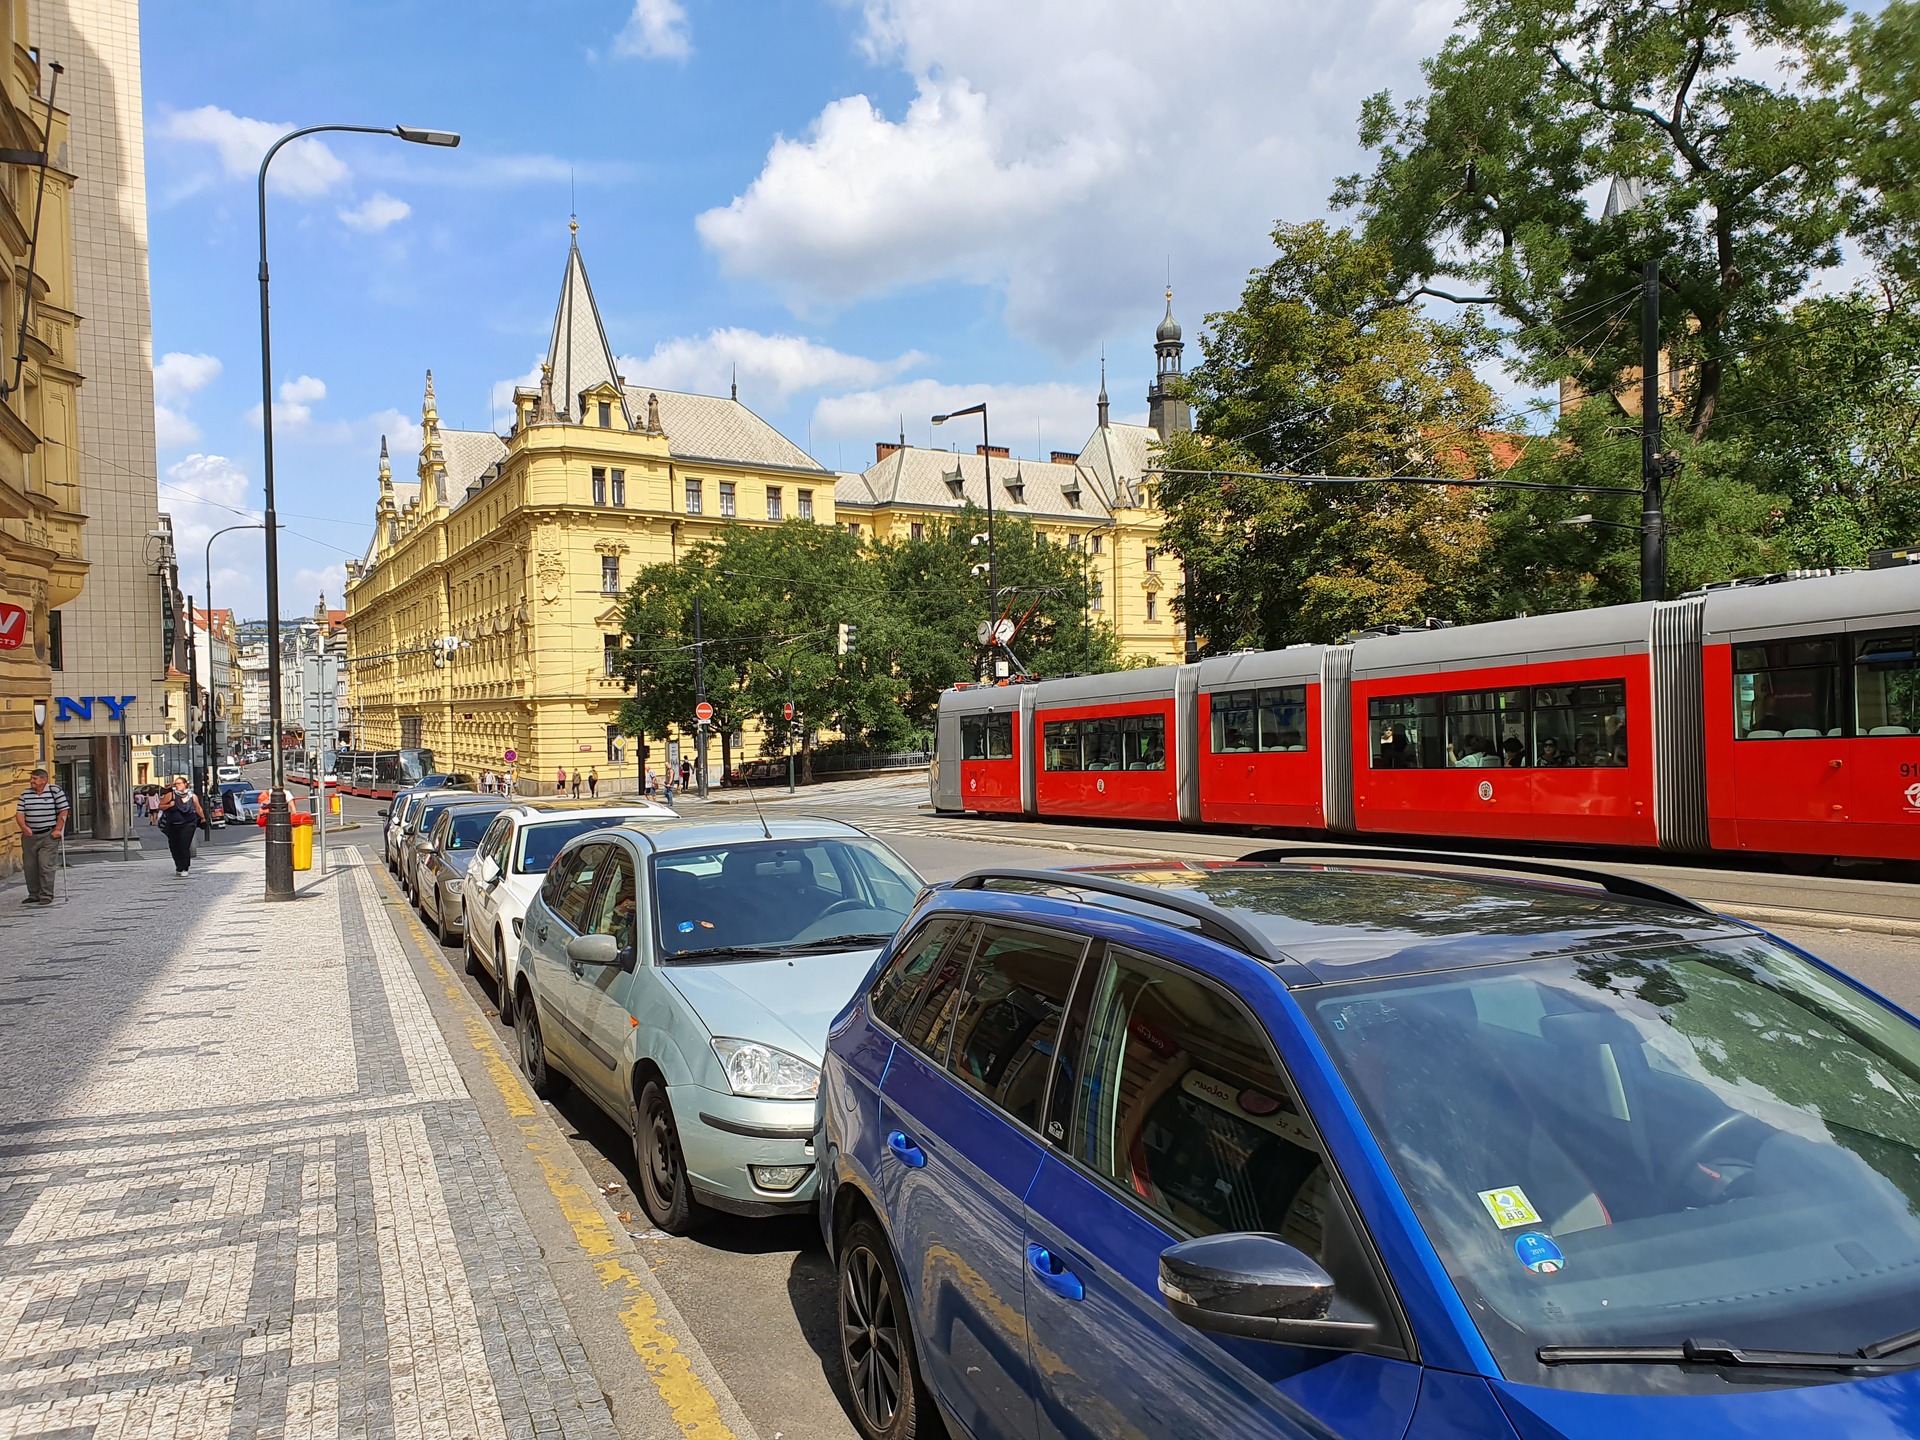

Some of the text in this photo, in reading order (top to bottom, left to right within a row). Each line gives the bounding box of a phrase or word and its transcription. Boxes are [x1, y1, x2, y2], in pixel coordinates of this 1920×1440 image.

[54, 695, 137, 721] NY
[55, 743, 78, 751] Center
[1900, 762, 1920, 778] 91
[1525, 1237, 1538, 1247] R
[1531, 1247, 1546, 1256] 2019
